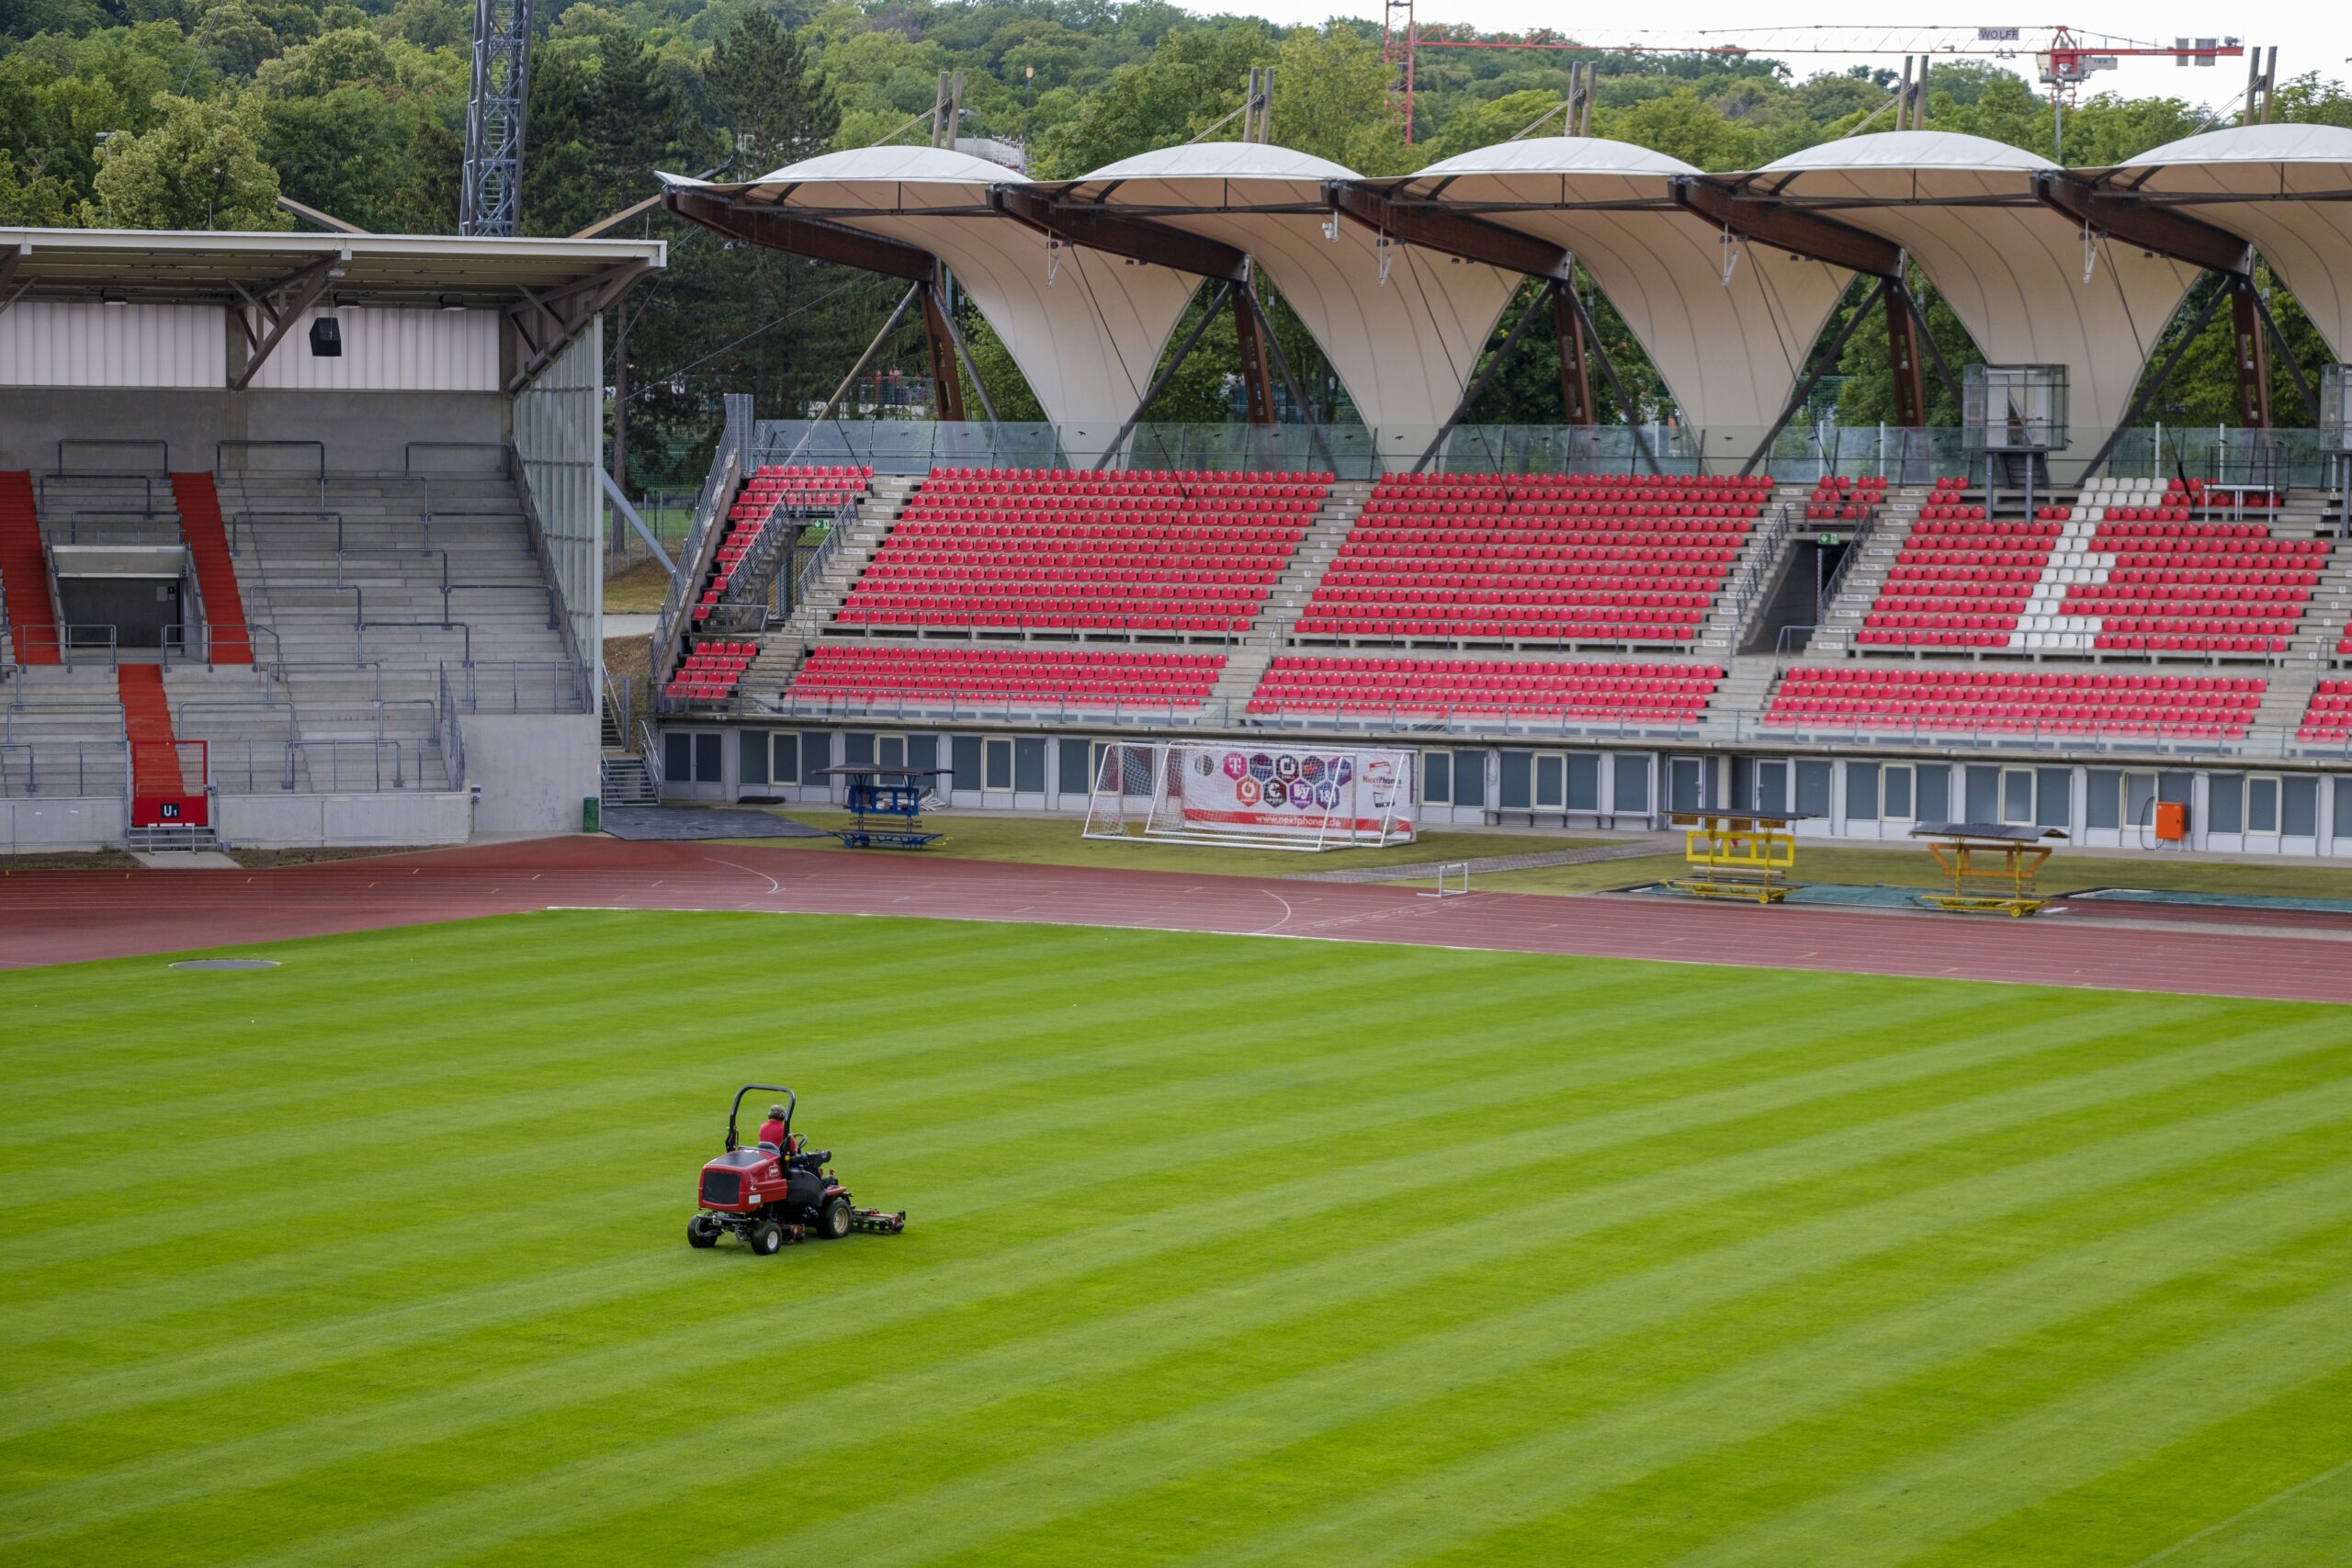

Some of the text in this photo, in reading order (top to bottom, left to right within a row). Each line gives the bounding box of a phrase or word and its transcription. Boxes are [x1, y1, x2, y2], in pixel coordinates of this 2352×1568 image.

[1980, 29, 2018, 39] WOLFF
[1363, 775, 1402, 784] NextPhons
[1255, 815, 1341, 827] www.nextphone.de
